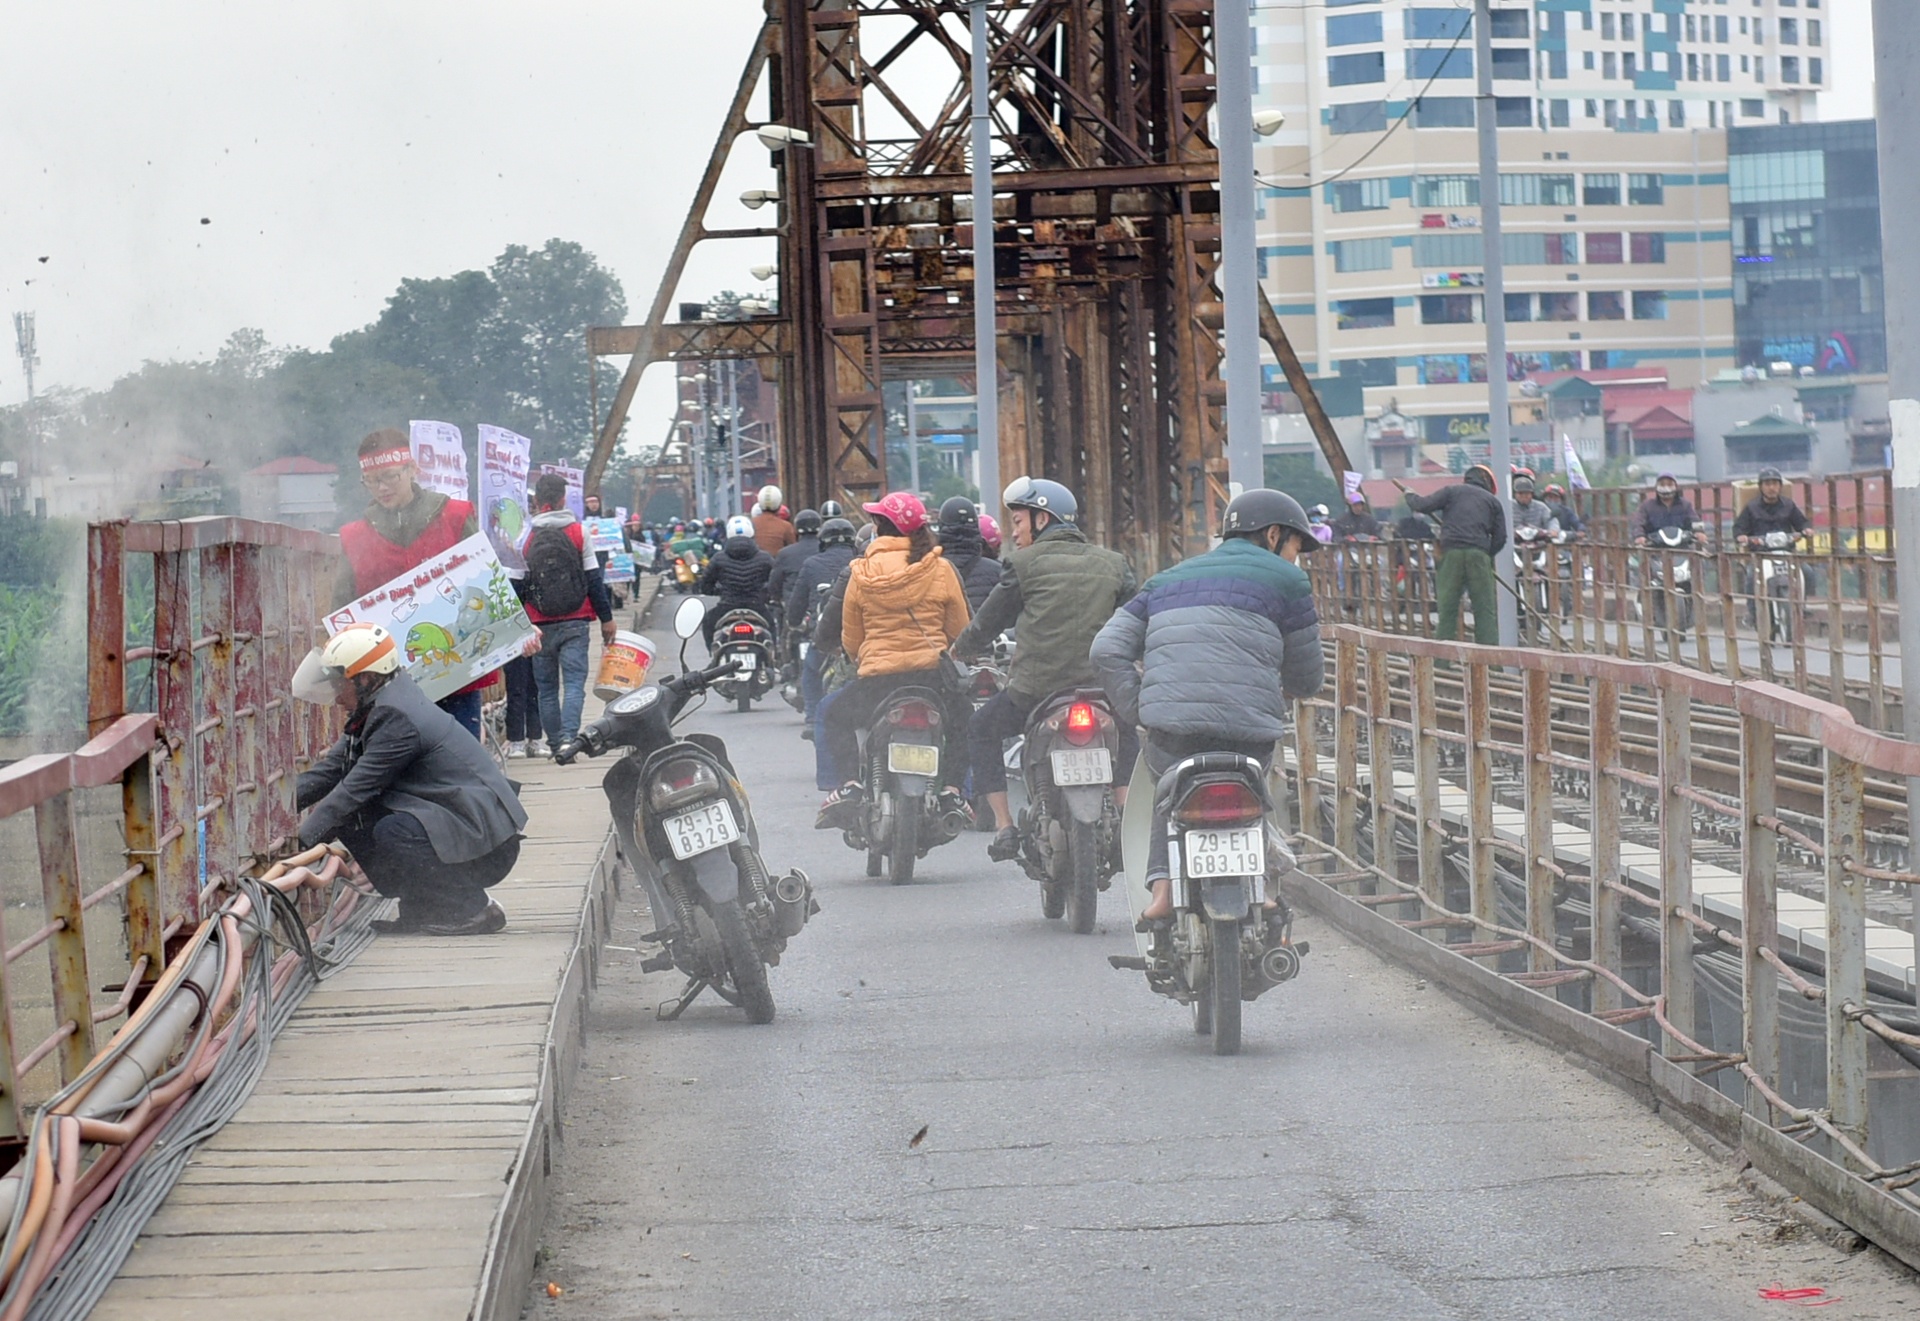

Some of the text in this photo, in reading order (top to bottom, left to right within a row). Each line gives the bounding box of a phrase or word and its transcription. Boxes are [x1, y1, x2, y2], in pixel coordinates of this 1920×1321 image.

[1061, 752, 1101, 768] 30-N1
[1062, 767, 1104, 783] 5539
[674, 805, 724, 836] 29-T3
[680, 823, 730, 853] 8329
[1198, 831, 1250, 852] 29-E1
[1193, 853, 1258, 875] 683.19
